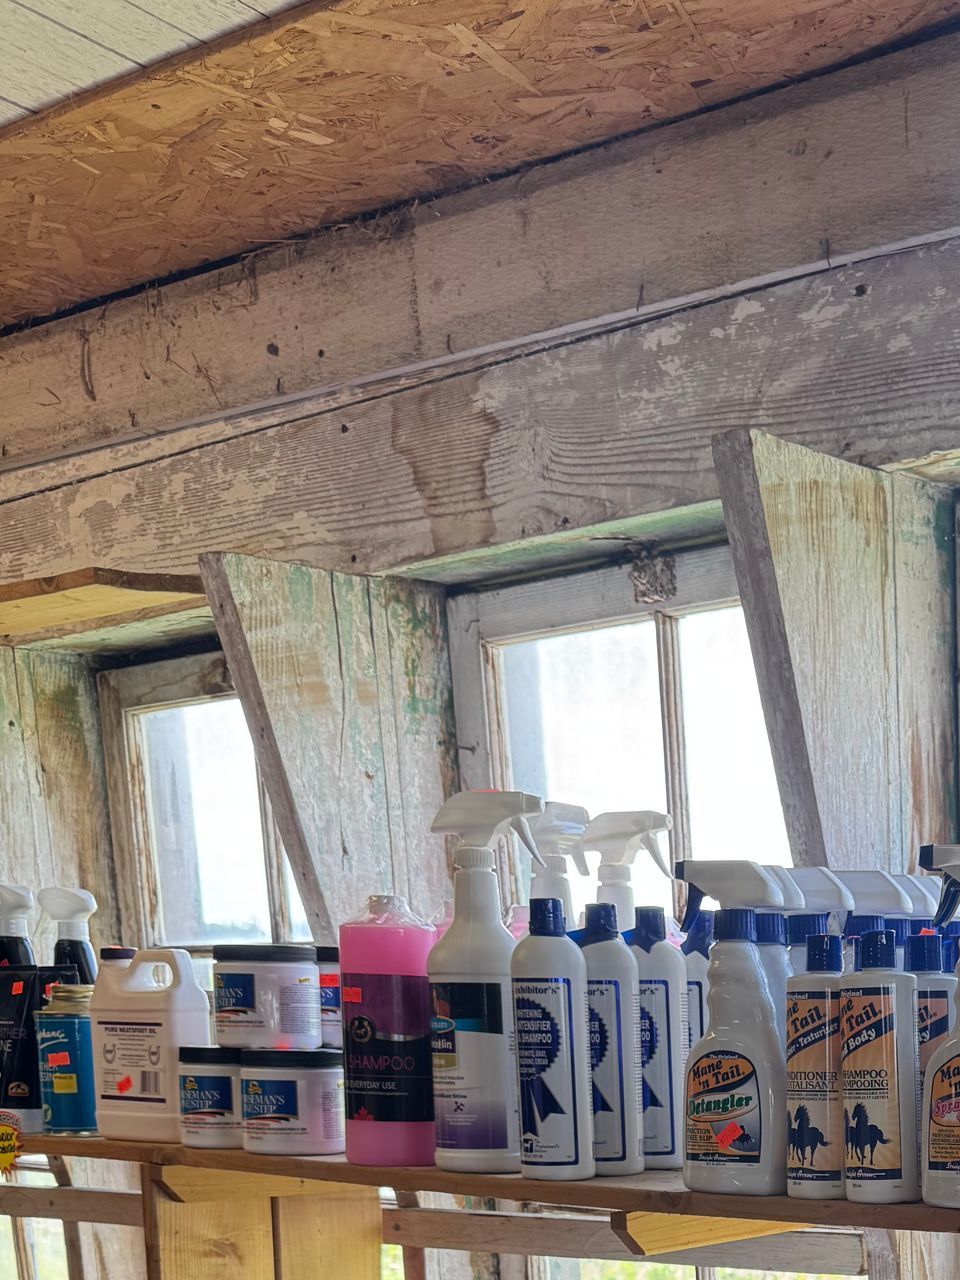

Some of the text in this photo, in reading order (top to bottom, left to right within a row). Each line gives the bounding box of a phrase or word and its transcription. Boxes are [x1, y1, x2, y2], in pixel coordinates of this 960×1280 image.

[791, 1006, 823, 1034] Tail
[845, 1001, 878, 1030] Tail
[798, 1022, 838, 1047] Texturizer
[848, 1027, 876, 1050] Body
[348, 1056, 415, 1071] SHAMPOO
[692, 1060, 723, 1081] Mane
[350, 1080, 380, 1089] EVERYDAY
[712, 1065, 742, 1085] Tail
[689, 1094, 753, 1116] Detangler
